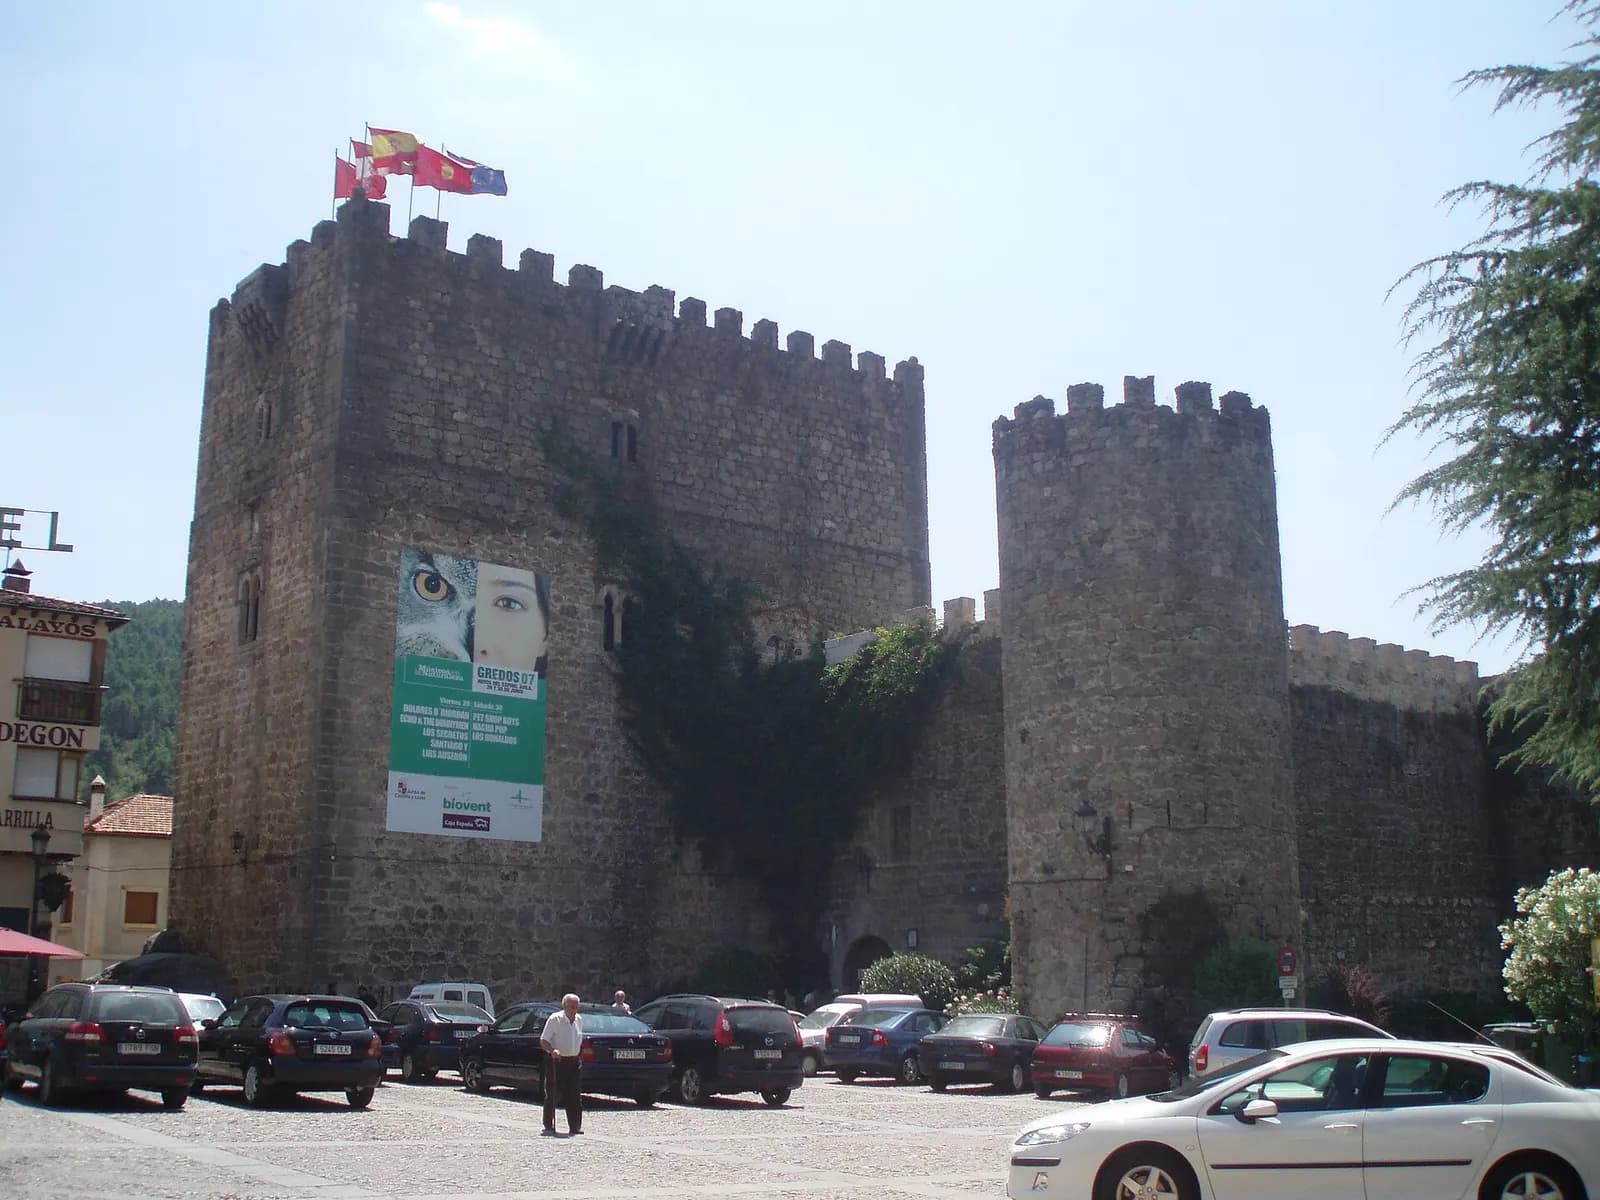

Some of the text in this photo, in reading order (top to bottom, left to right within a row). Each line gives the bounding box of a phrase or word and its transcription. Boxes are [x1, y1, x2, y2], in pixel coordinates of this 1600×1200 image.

[0, 615, 97, 637] ALAYOS
[477, 666, 535, 685] GREDOS 07
[0, 722, 86, 747] DEGON
